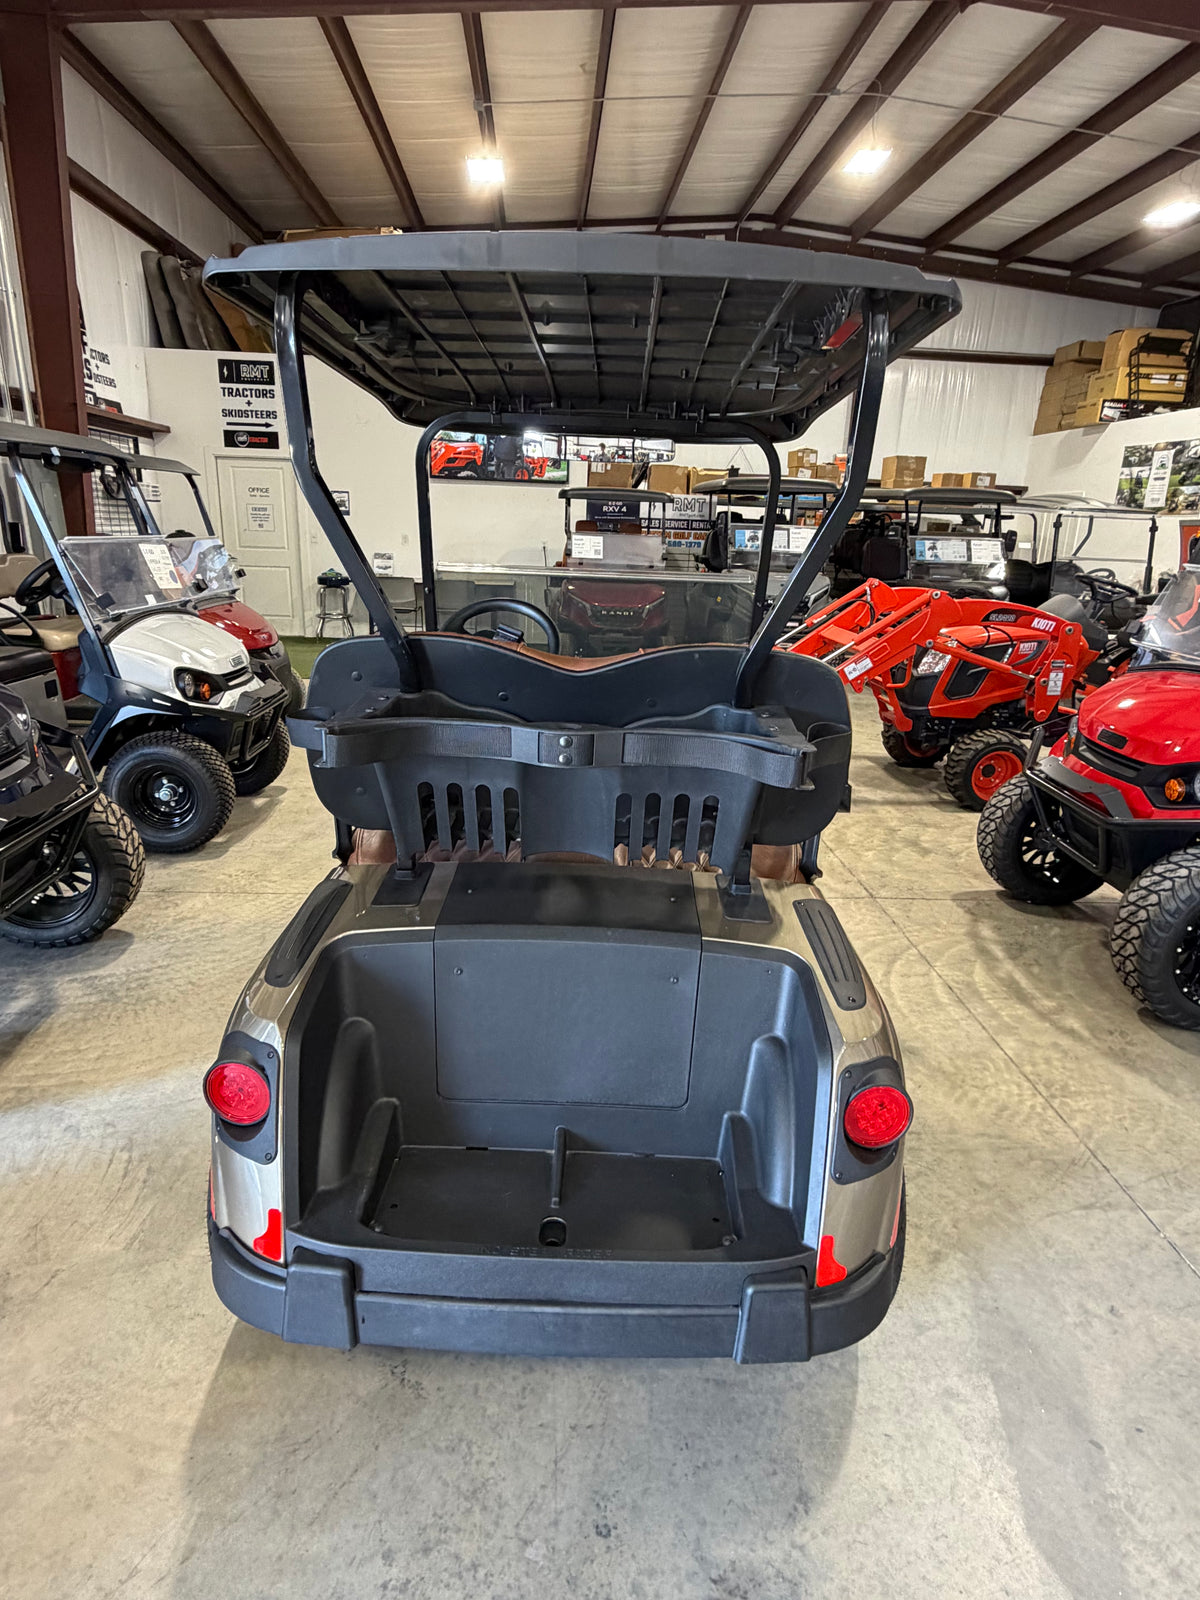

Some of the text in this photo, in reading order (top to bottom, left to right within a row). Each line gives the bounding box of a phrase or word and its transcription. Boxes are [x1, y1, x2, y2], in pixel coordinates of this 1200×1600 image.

[240, 364, 269, 378] RMT
[220, 386, 276, 399] TRACTORS
[221, 408, 278, 420] SKIDSTEERS
[248, 486, 270, 494] OFFICE
[602, 505, 627, 513] RXV 4
[672, 497, 706, 513] RMT
[664, 520, 688, 529] SERVICE
[1031, 616, 1057, 633] KIOTI
[1019, 642, 1038, 652] KIOTI
